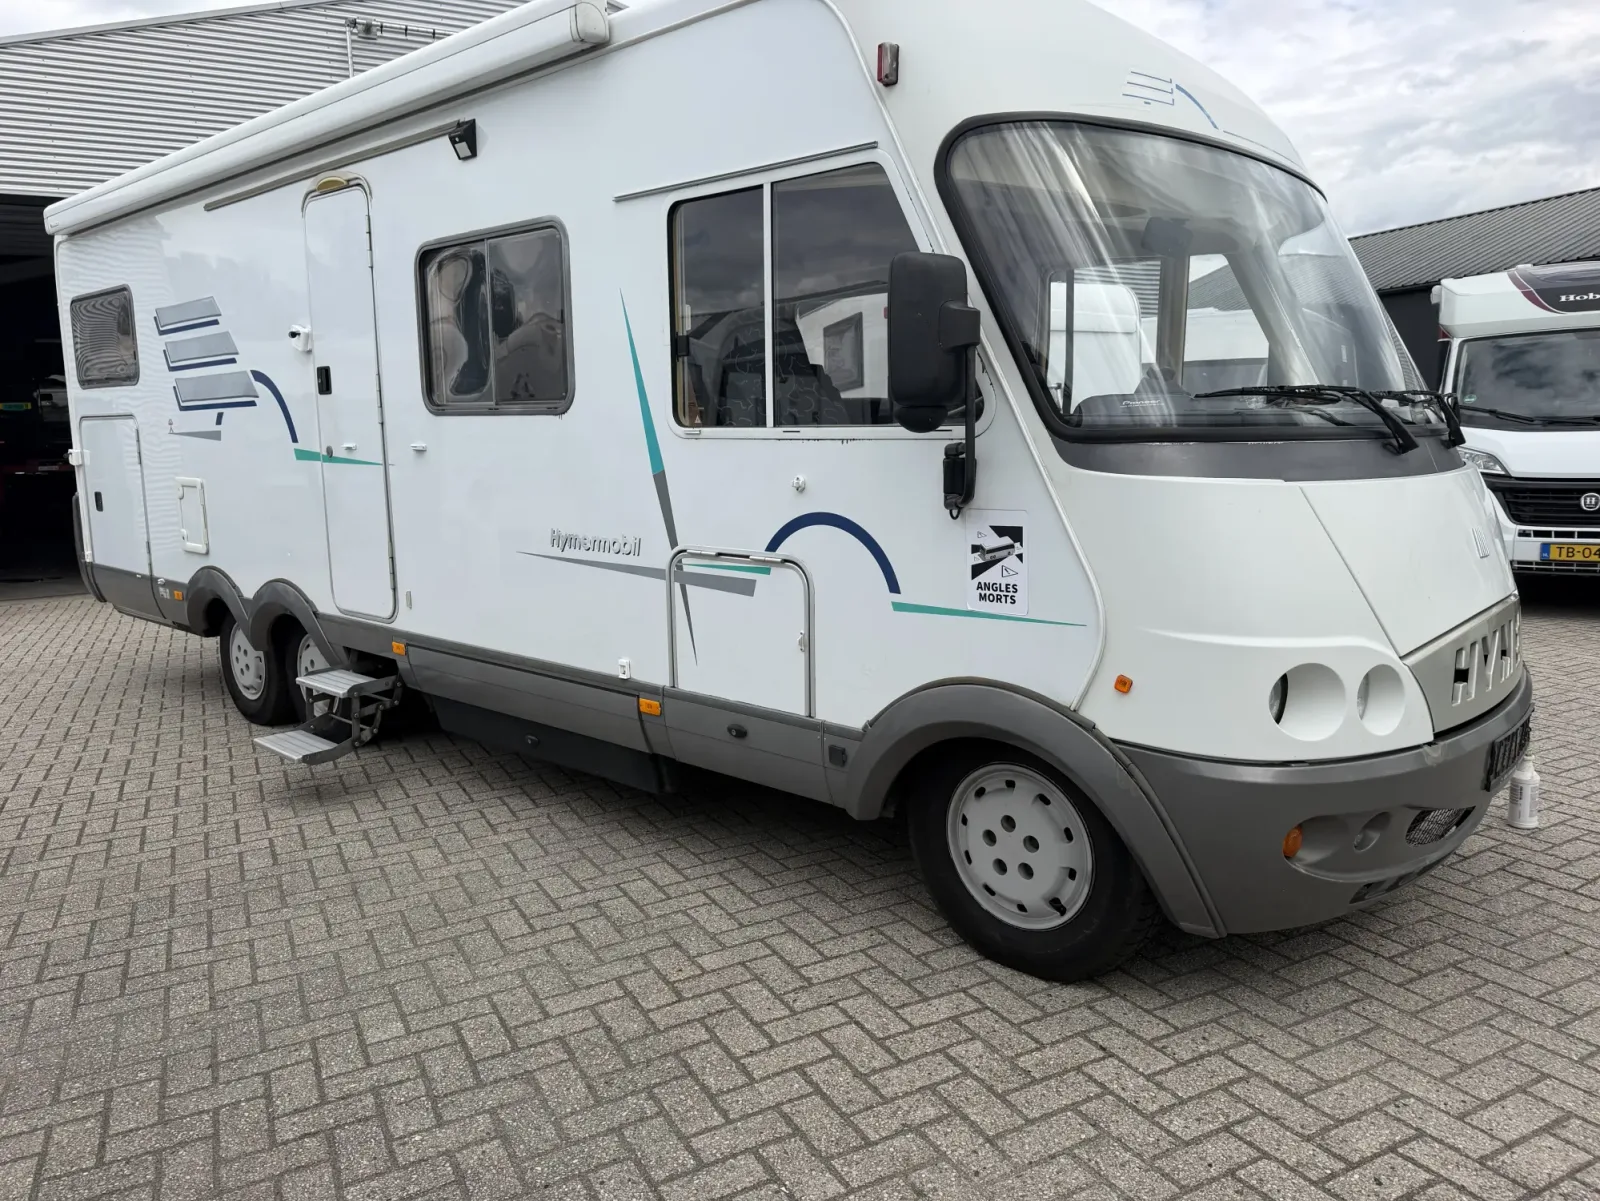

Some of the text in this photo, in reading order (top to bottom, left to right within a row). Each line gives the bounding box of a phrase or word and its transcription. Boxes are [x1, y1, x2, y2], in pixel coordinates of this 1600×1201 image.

[550, 527, 641, 557] Hymermobil
[976, 581, 1018, 594] ANGLES
[978, 592, 1017, 605] MORTS
